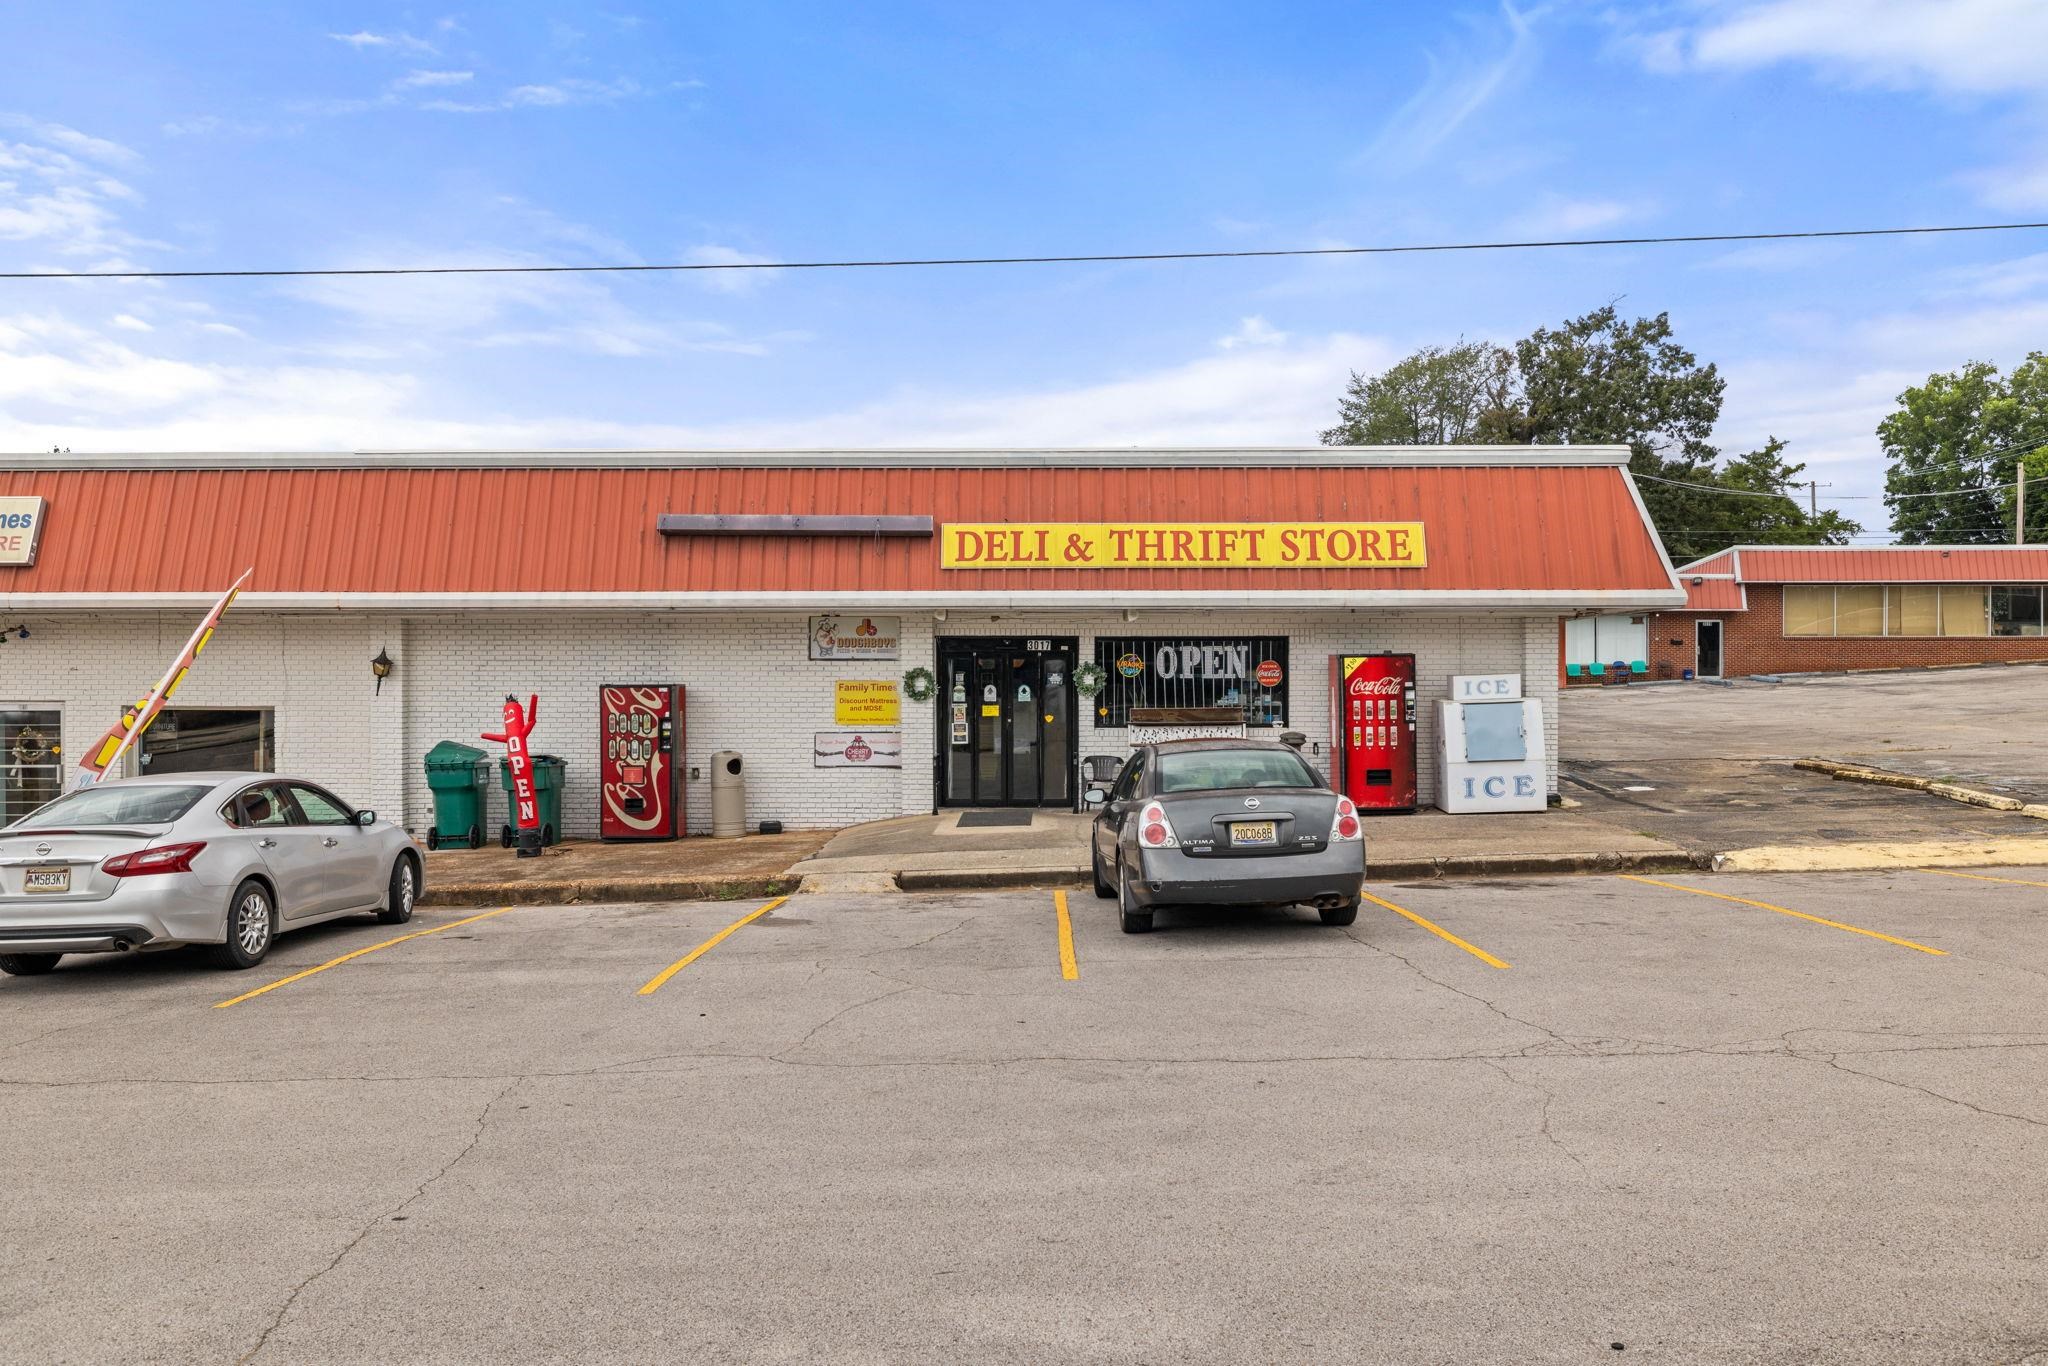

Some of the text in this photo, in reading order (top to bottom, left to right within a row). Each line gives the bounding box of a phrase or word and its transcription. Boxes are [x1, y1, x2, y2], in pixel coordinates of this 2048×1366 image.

[955, 529, 1413, 562] DELI & THRIFT STORE
[836, 637, 897, 648] DOUGHBOYS
[1028, 640, 1051, 650] 3017
[1156, 645, 1248, 679] OPEN
[838, 683, 897, 693] Family Times
[1350, 676, 1403, 695] Coca-Cola
[1464, 680, 1510, 696] ICE
[508, 736, 534, 820] OPEN
[1463, 775, 1537, 799] ICE
